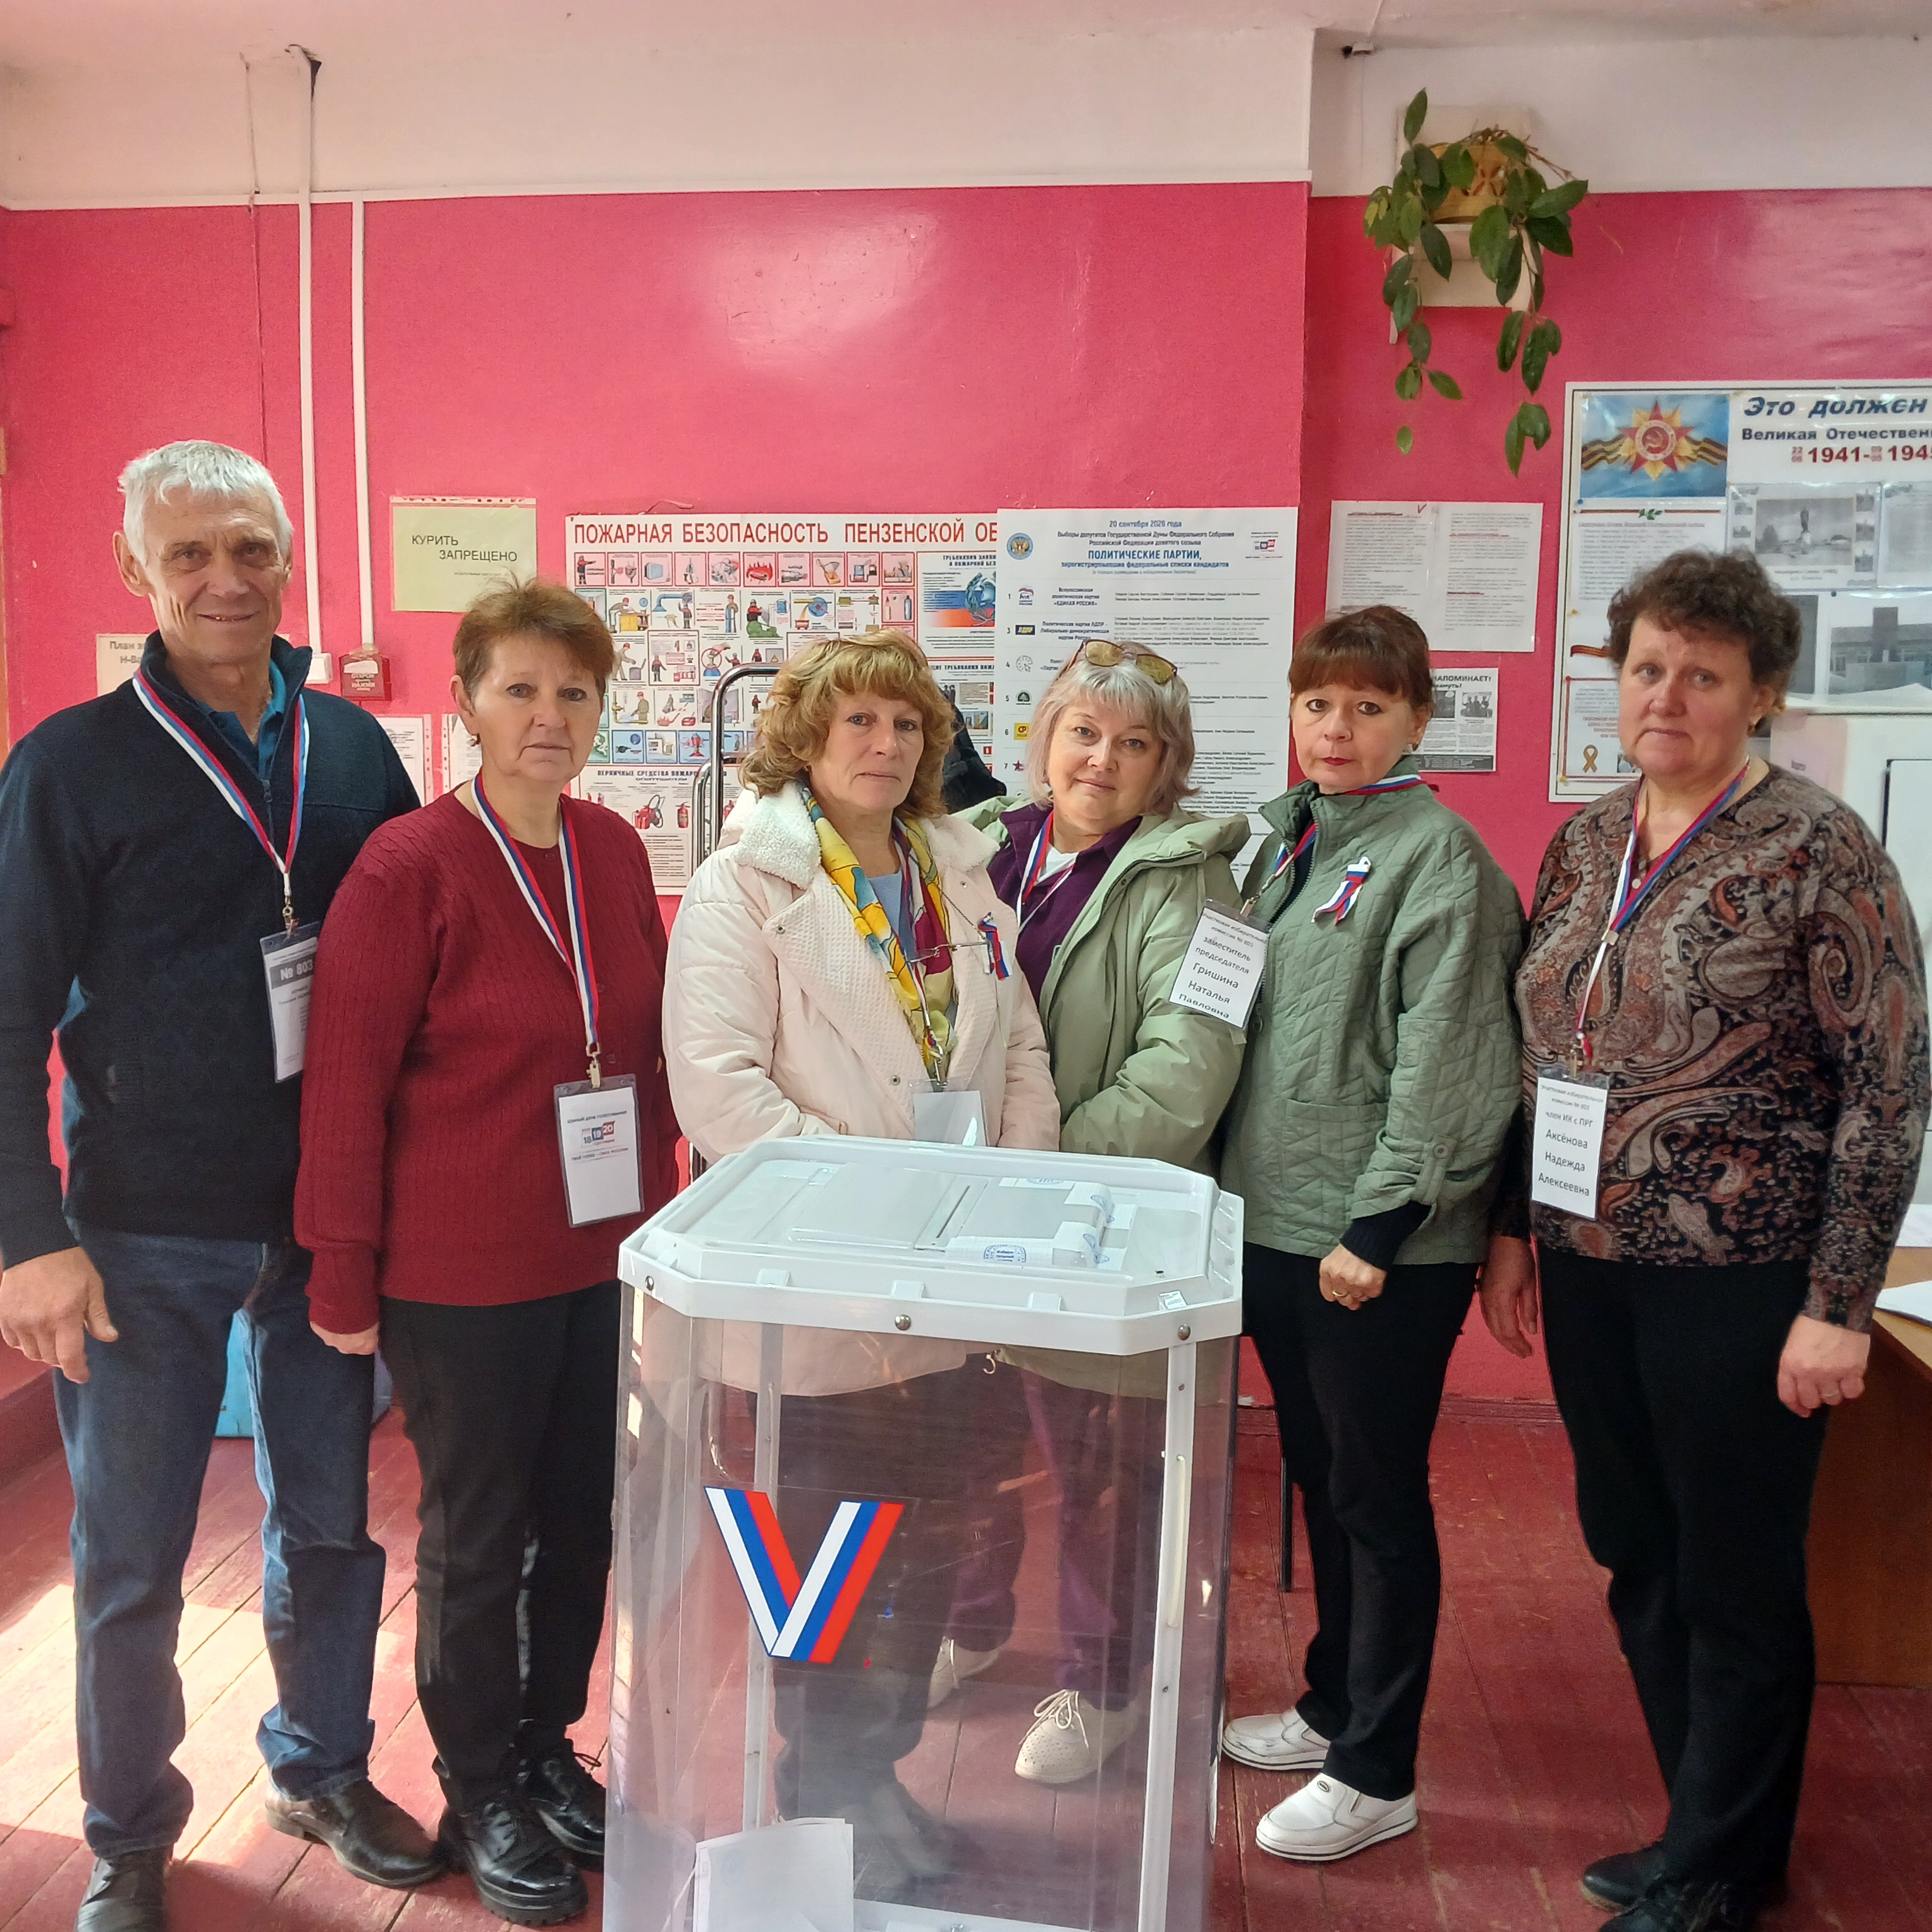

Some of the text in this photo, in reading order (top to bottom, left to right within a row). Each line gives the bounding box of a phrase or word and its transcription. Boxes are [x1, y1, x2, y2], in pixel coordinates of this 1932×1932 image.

[1744, 396, 1928, 419] Это должен
[1742, 427, 1932, 441] Великая Отечествен
[1887, 444, 1932, 462] 194
[575, 523, 672, 543] ПОЖАРНАЯ
[683, 522, 829, 543] БЕЗОПАСНОСТЬ
[845, 518, 964, 543] ПЕНЗЕНСКОЙ
[1118, 520, 1149, 529] сентября
[412, 535, 458, 546] КУРИТЬ
[439, 549, 517, 562] ЗАПРЕЩЕНО
[1088, 549, 1202, 560] ПОЛИТИЧЕСКИЕ ПАРТИИ,
[1202, 936, 1251, 962] заместитель
[279, 959, 314, 981] № 803
[1195, 947, 1250, 974] председателя
[1192, 962, 1239, 989] Гришина
[1188, 980, 1230, 1004] Наталья
[1178, 993, 1230, 1018] Павловна
[1545, 1111, 1562, 1120] член
[1563, 1114, 1573, 1123] ИК
[583, 1124, 613, 1144] 18 19 20
[1546, 1128, 1588, 1149] Аксёнова
[1545, 1151, 1586, 1173] Надежда
[1538, 1172, 1590, 1197] Алексеевна
